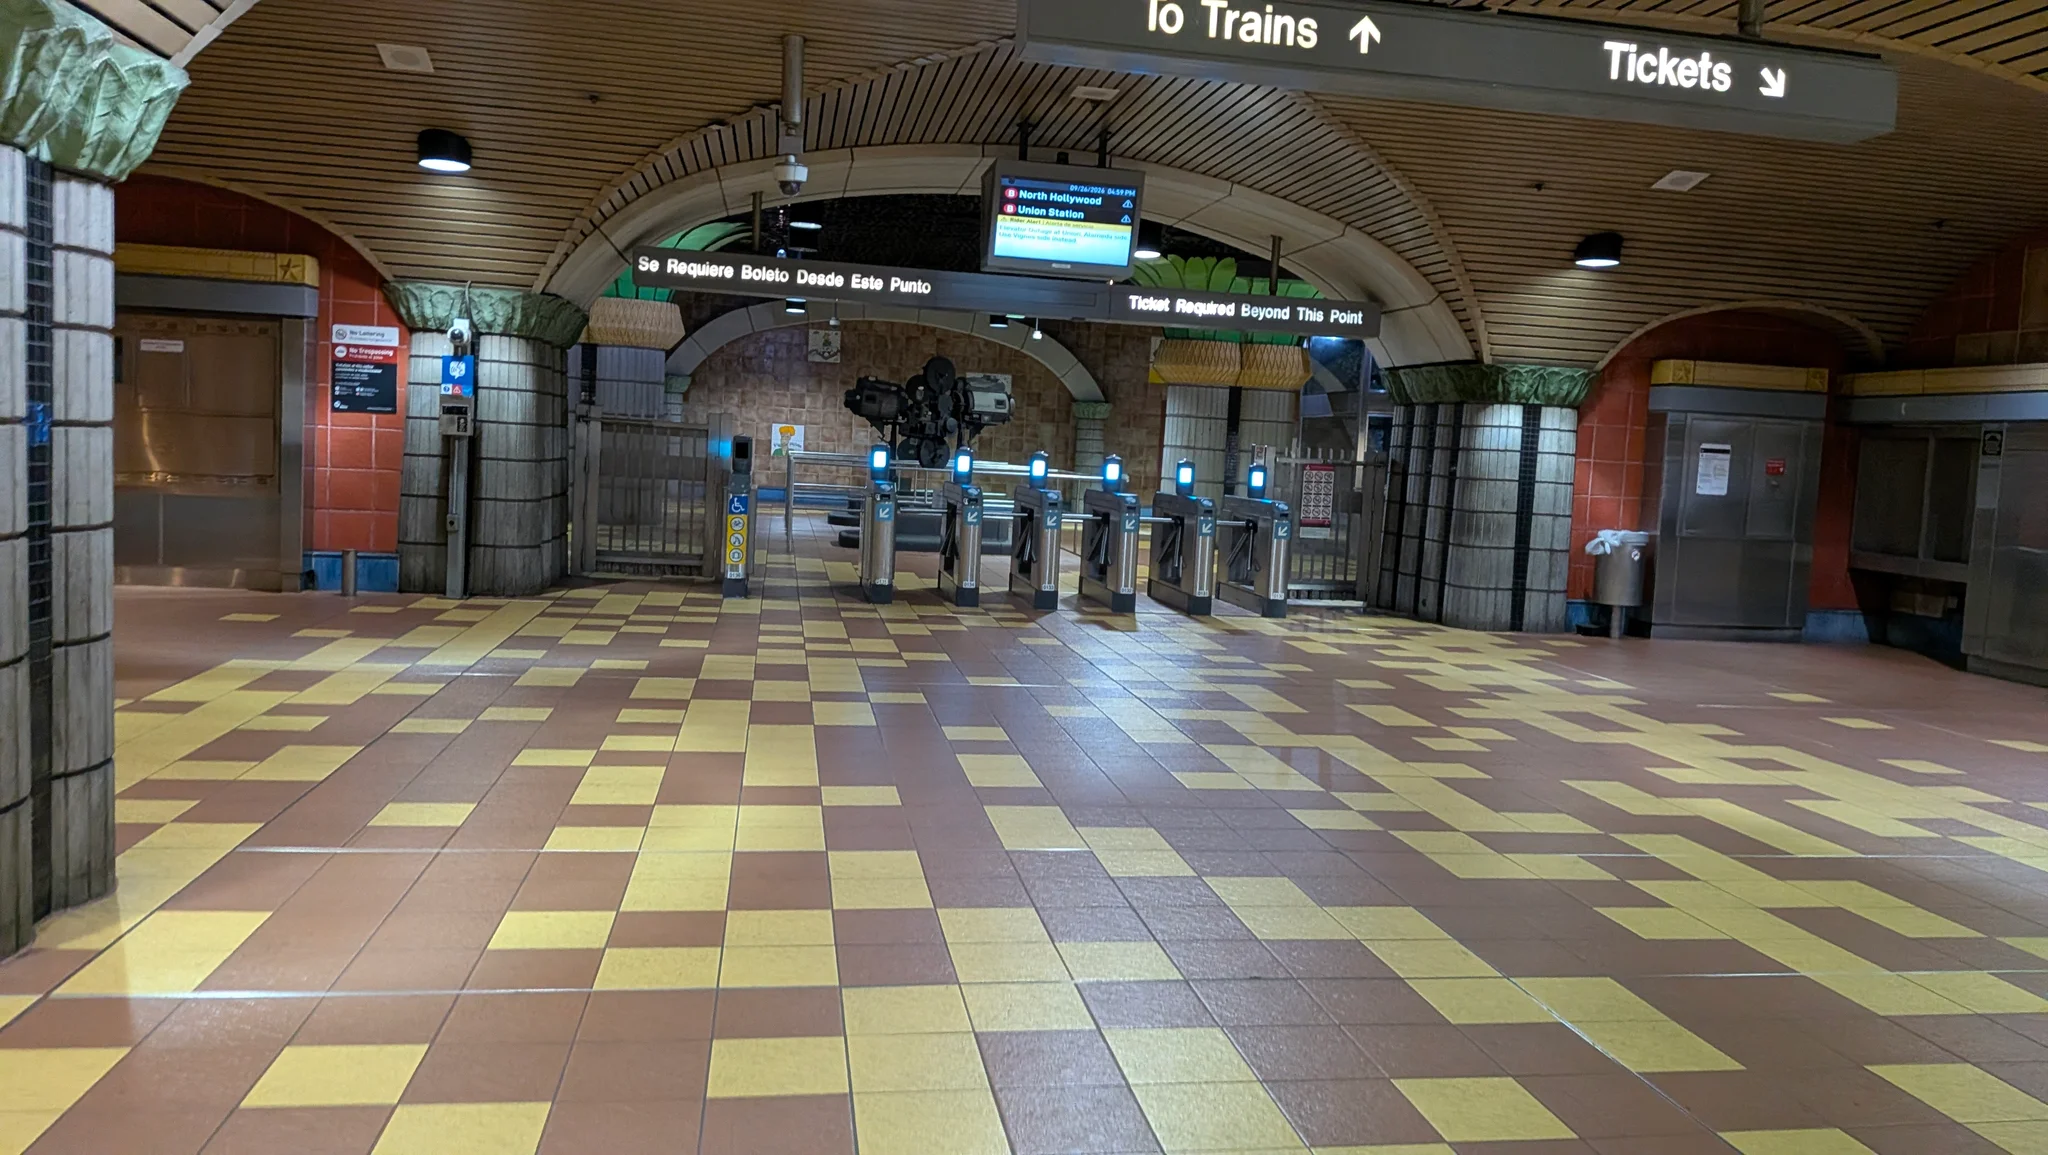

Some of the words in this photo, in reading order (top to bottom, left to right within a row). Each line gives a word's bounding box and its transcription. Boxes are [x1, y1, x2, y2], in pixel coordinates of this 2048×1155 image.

[1148, 0, 1184, 35] To
[1201, 0, 1318, 49] Trains
[1603, 40, 1732, 92] Tickets
[1017, 205, 1047, 216] Union
[1048, 207, 1085, 219] Station
[1018, 189, 1049, 201] North
[1049, 192, 1102, 206] Hollywood
[637, 256, 660, 273] Se
[666, 258, 735, 279] Requiere
[740, 264, 790, 283] Boleto
[796, 269, 845, 288] Desde
[850, 273, 884, 291] Este
[889, 276, 932, 295] Punto
[1128, 294, 1171, 312] Ticket
[1175, 298, 1236, 317] Required
[1240, 302, 1290, 321] Beyond
[1296, 306, 1325, 323] This
[1329, 308, 1363, 325] Point
